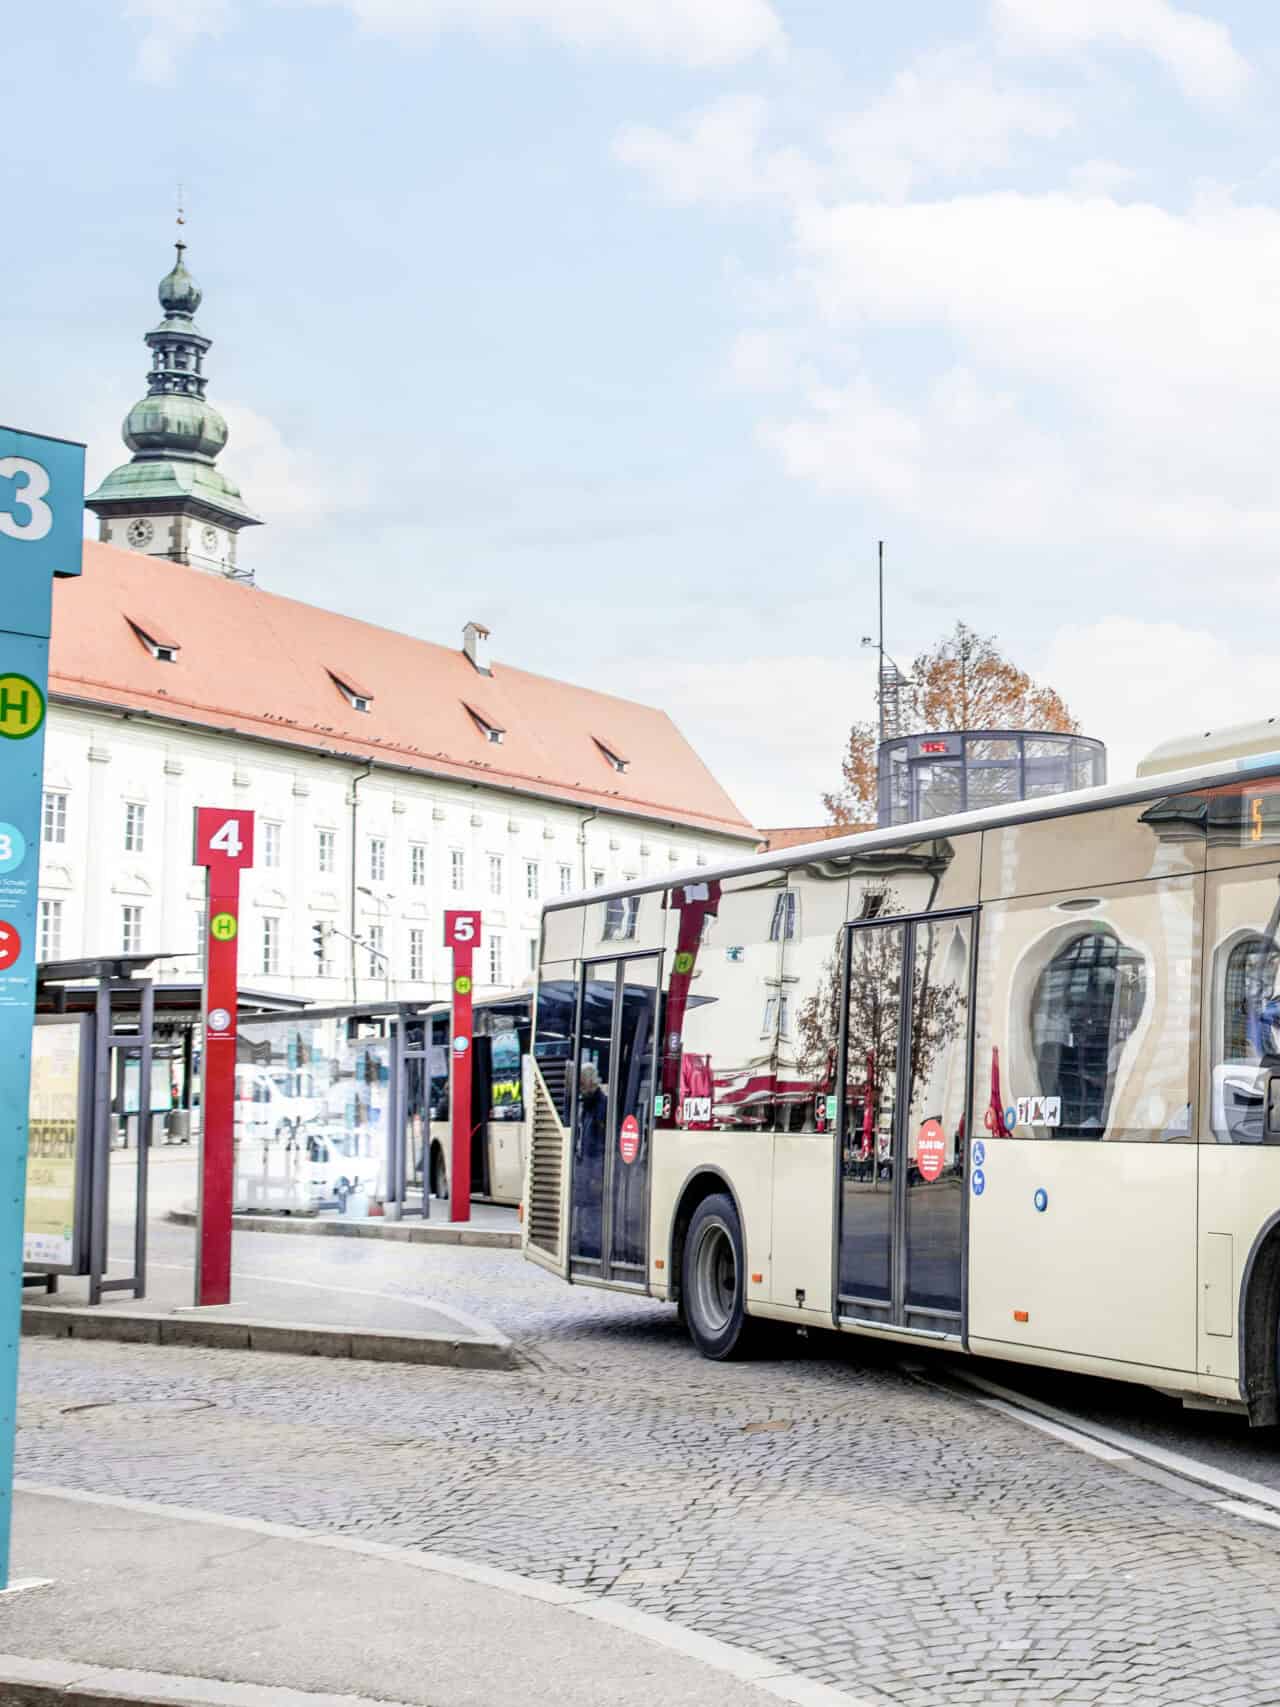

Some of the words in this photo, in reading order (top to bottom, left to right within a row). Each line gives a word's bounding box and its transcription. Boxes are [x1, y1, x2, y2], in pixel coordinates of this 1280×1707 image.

[0, 456, 53, 540] 3
[1, 688, 28, 724] H
[208, 819, 243, 857] 4
[217, 919, 232, 935] H
[453, 916, 475, 941] 5
